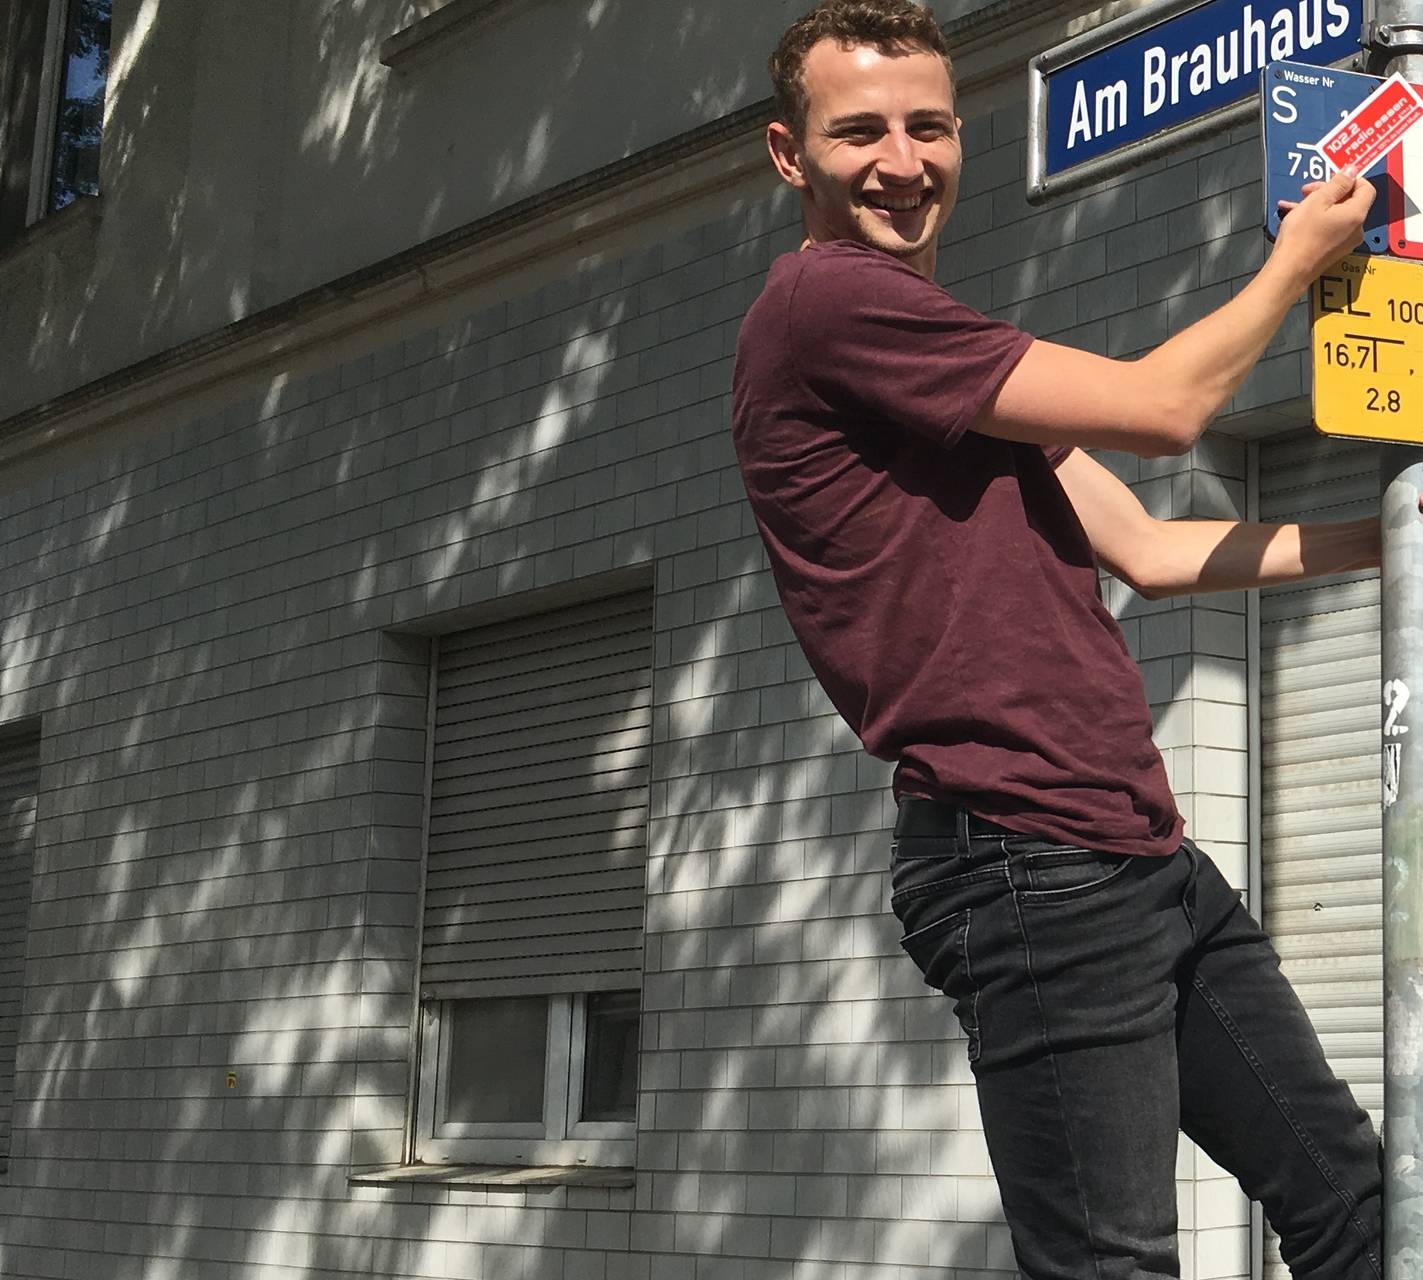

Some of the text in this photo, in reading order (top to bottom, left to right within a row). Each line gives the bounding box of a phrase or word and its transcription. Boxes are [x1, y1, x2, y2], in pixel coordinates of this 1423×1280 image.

[1066, 0, 1350, 149] Am Brauhaus
[1284, 70, 1335, 88] Wasser Nr
[1271, 85, 1298, 124] S
[1327, 122, 1361, 154] 102.2
[1345, 127, 1375, 155] radio
[1374, 97, 1408, 128] essen
[1341, 261, 1377, 275] Gas Nr
[1319, 275, 1371, 318] EL
[1366, 387, 1401, 413] 2,8
